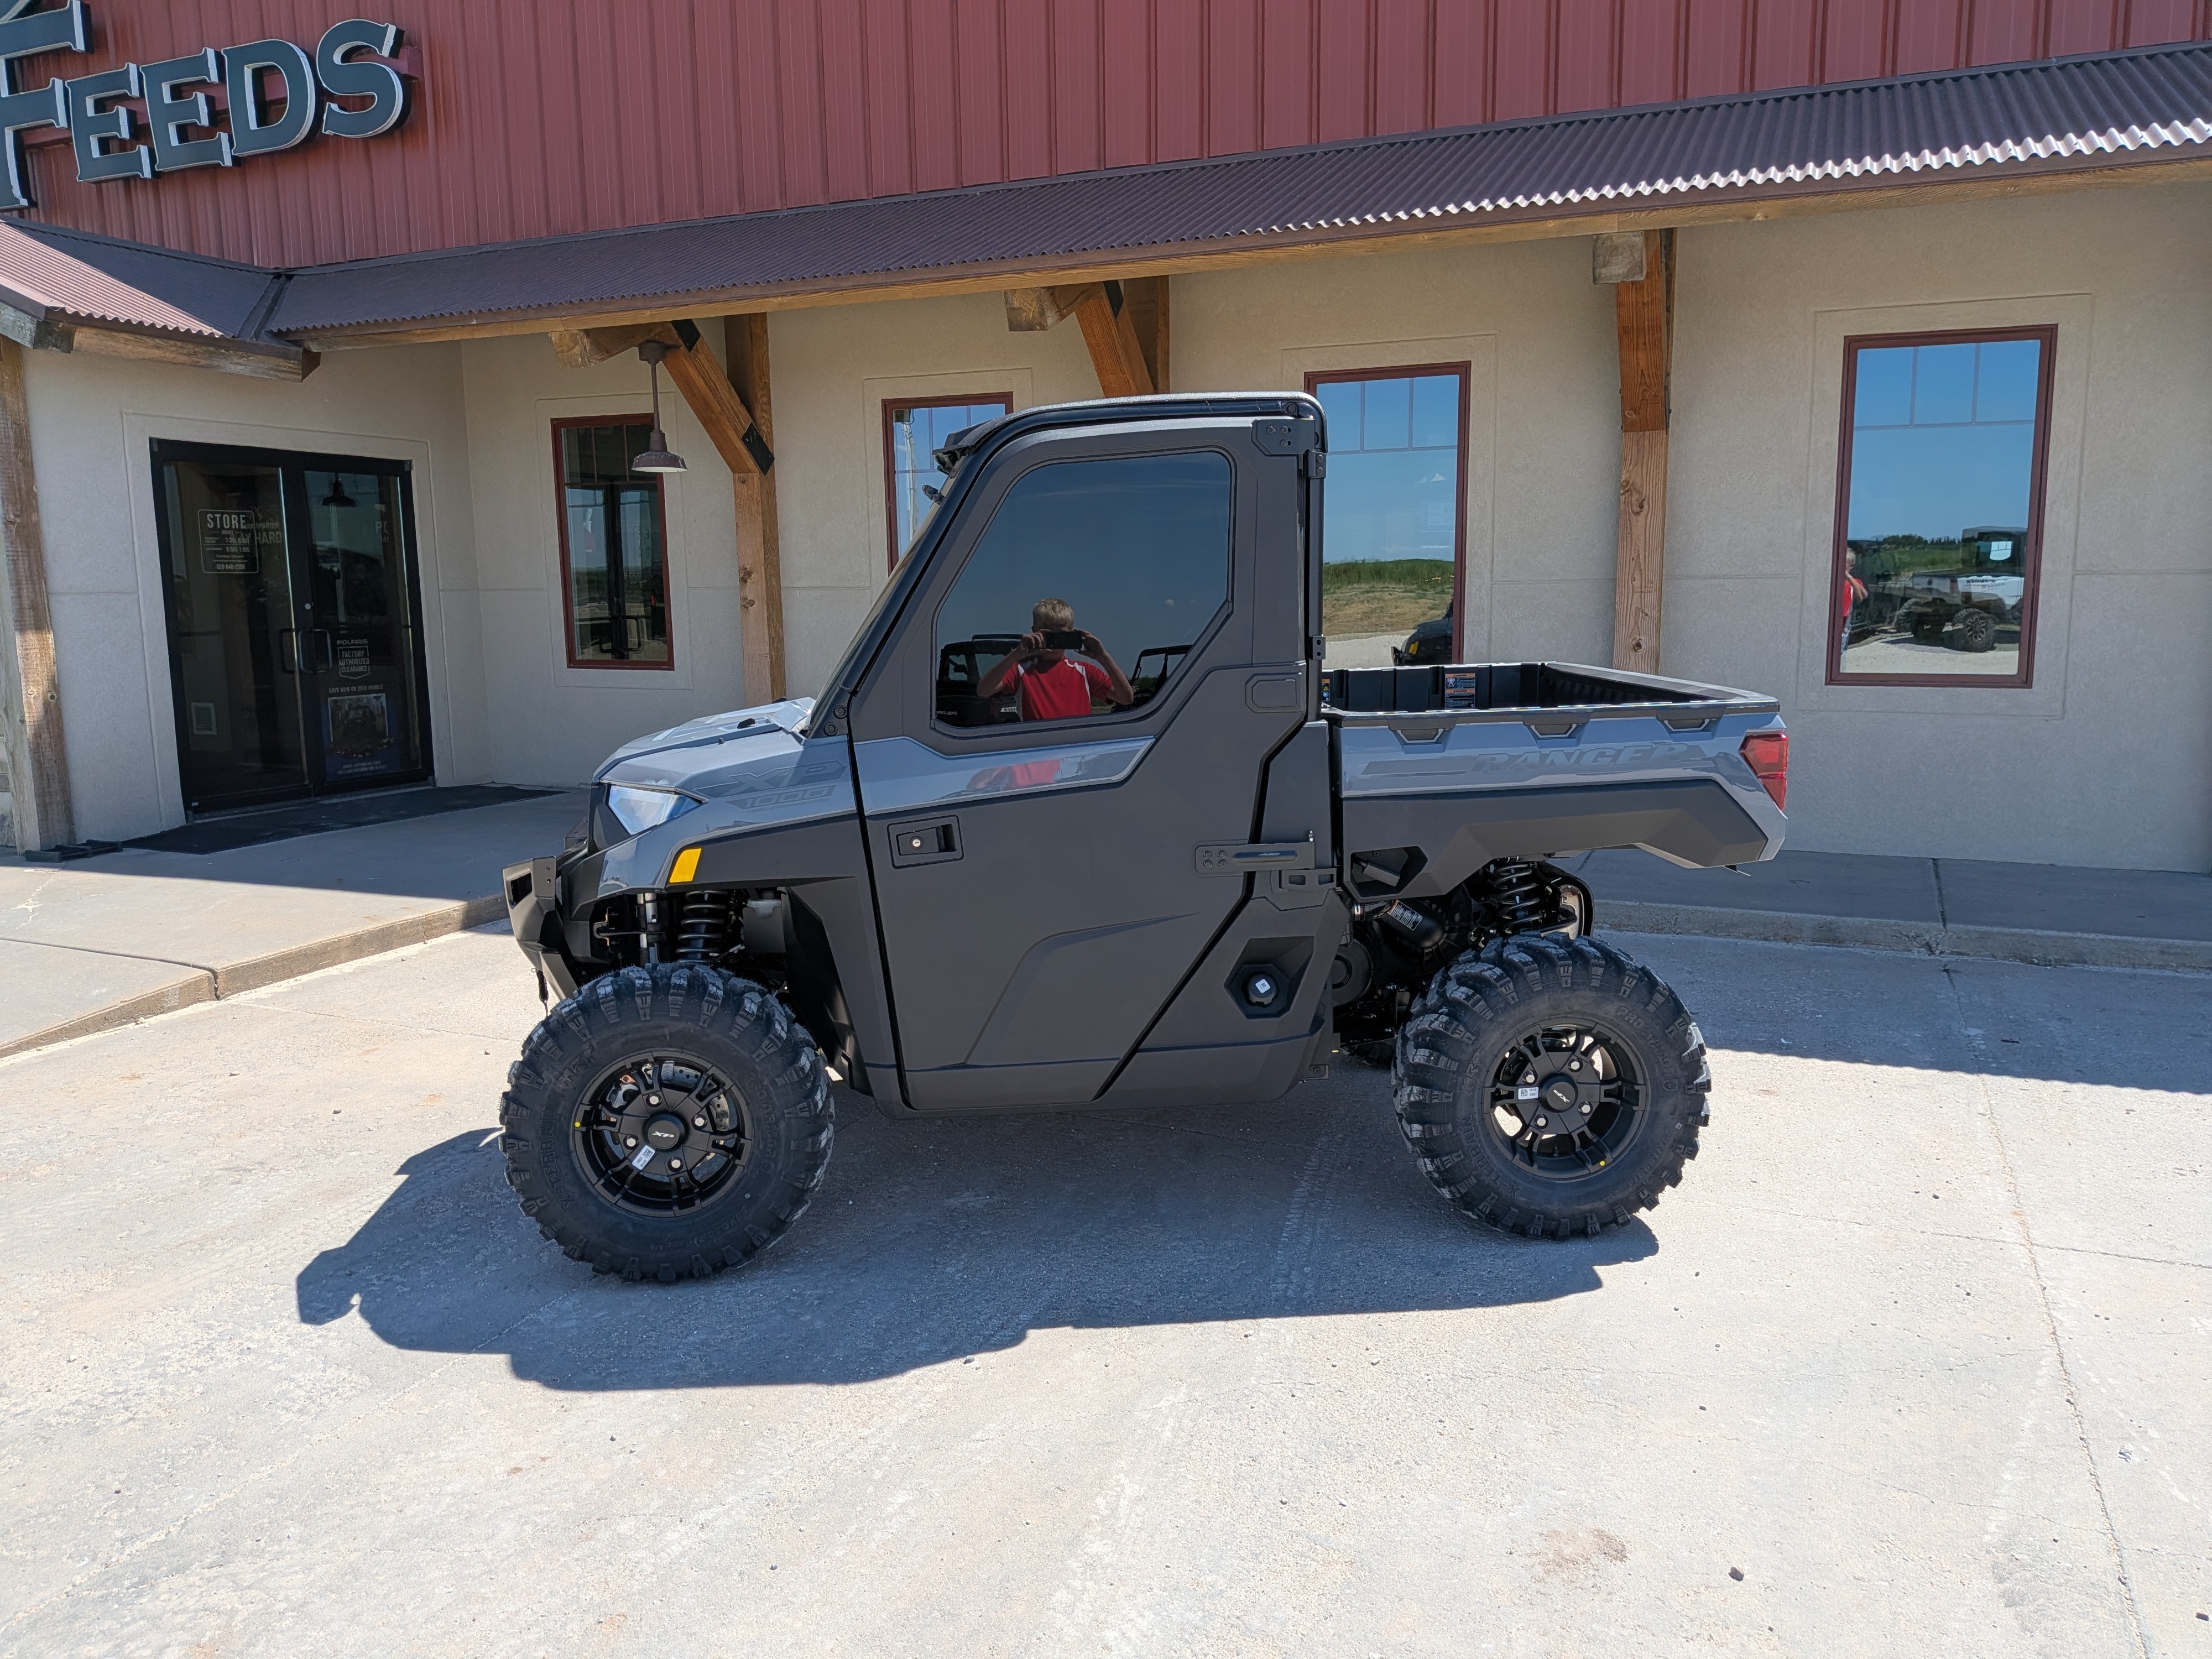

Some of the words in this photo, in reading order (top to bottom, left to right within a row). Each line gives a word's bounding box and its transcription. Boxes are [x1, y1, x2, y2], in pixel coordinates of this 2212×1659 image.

[207, 514, 247, 529] STORE
[254, 531, 282, 544] HARD
[338, 658, 370, 666] AUTHORIZED
[1465, 743, 1691, 775] RANGER
[745, 787, 830, 808] 1000
